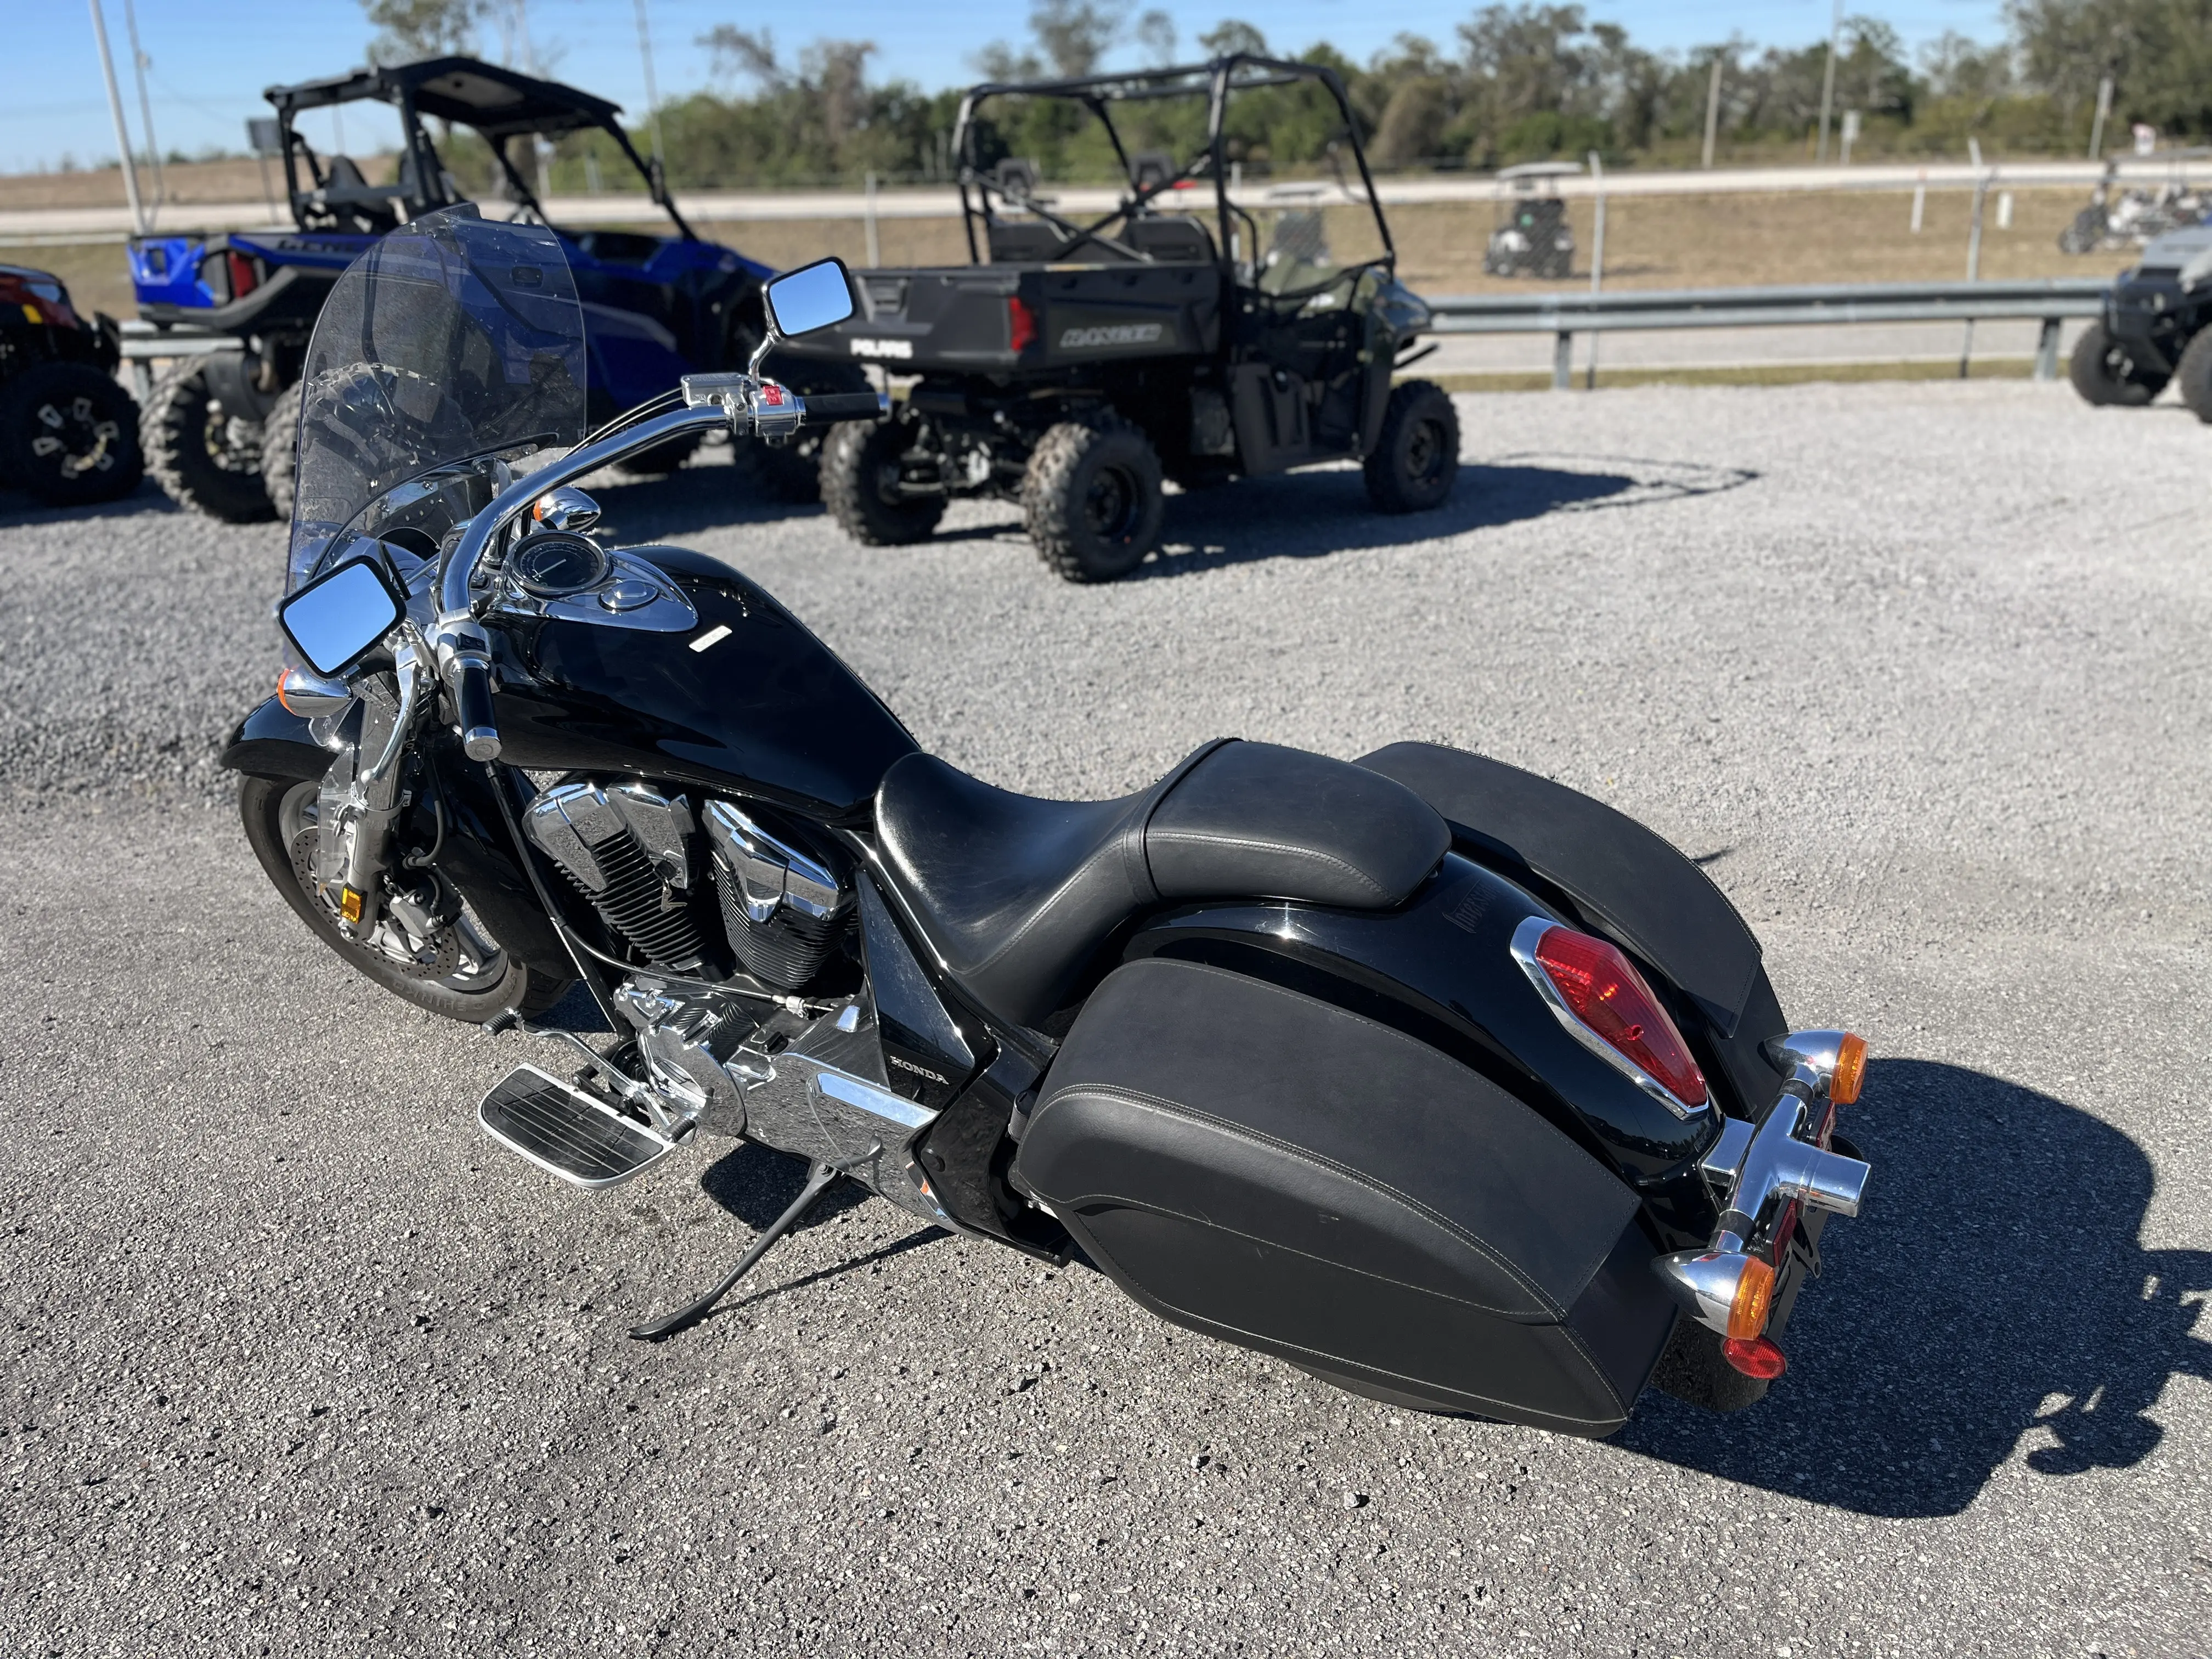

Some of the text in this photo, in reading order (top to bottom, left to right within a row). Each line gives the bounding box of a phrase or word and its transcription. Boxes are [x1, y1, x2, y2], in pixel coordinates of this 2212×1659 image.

[850, 338, 913, 359] POLARIS
[393, 979, 467, 1012] SHINKO
[890, 1056, 949, 1085] HONDA
